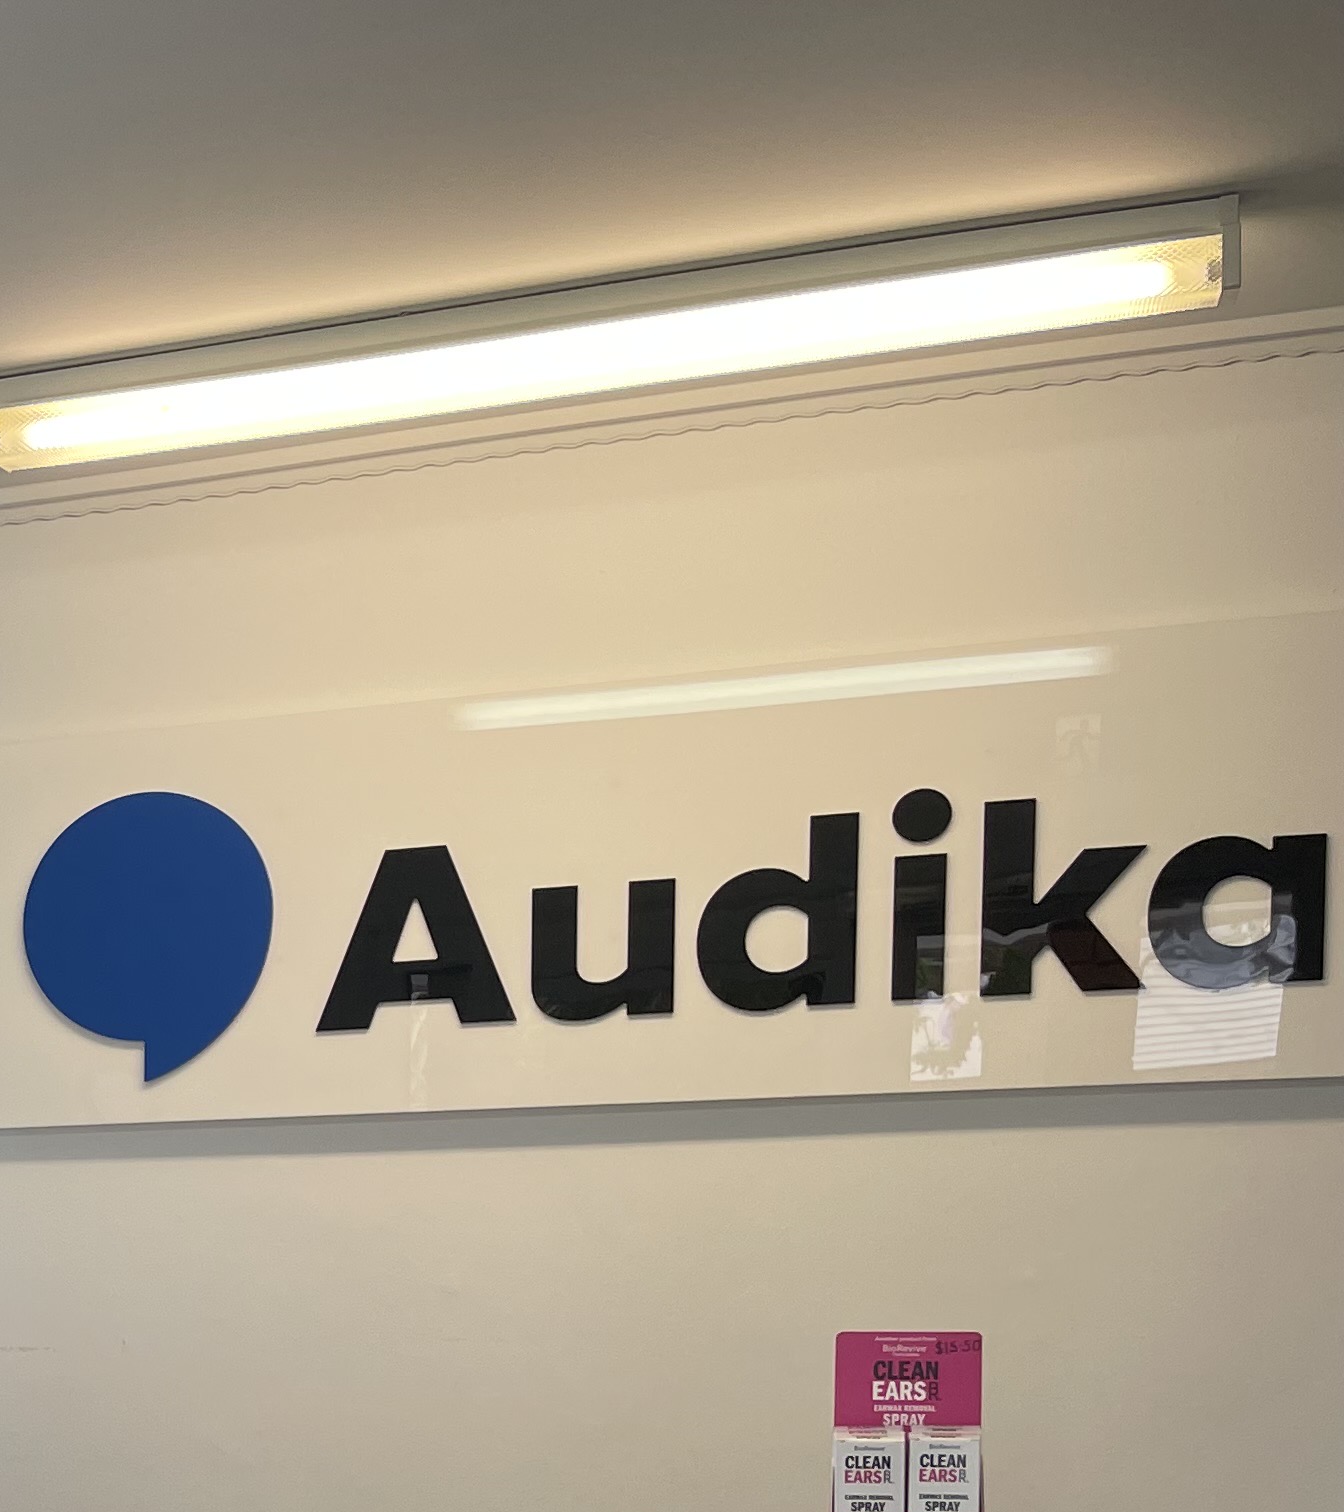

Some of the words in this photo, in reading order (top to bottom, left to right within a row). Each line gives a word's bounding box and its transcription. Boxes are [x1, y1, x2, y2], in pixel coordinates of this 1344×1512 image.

[316, 787, 1328, 1034] Audika
[873, 1360, 939, 1381] CLEAN
[882, 1413, 926, 1426] SPRAY
[844, 1455, 891, 1470] CLEAN
[919, 1453, 967, 1468] CLEAN
[850, 1501, 886, 1512] SPRAY
[924, 1501, 961, 1512] SPRAY
